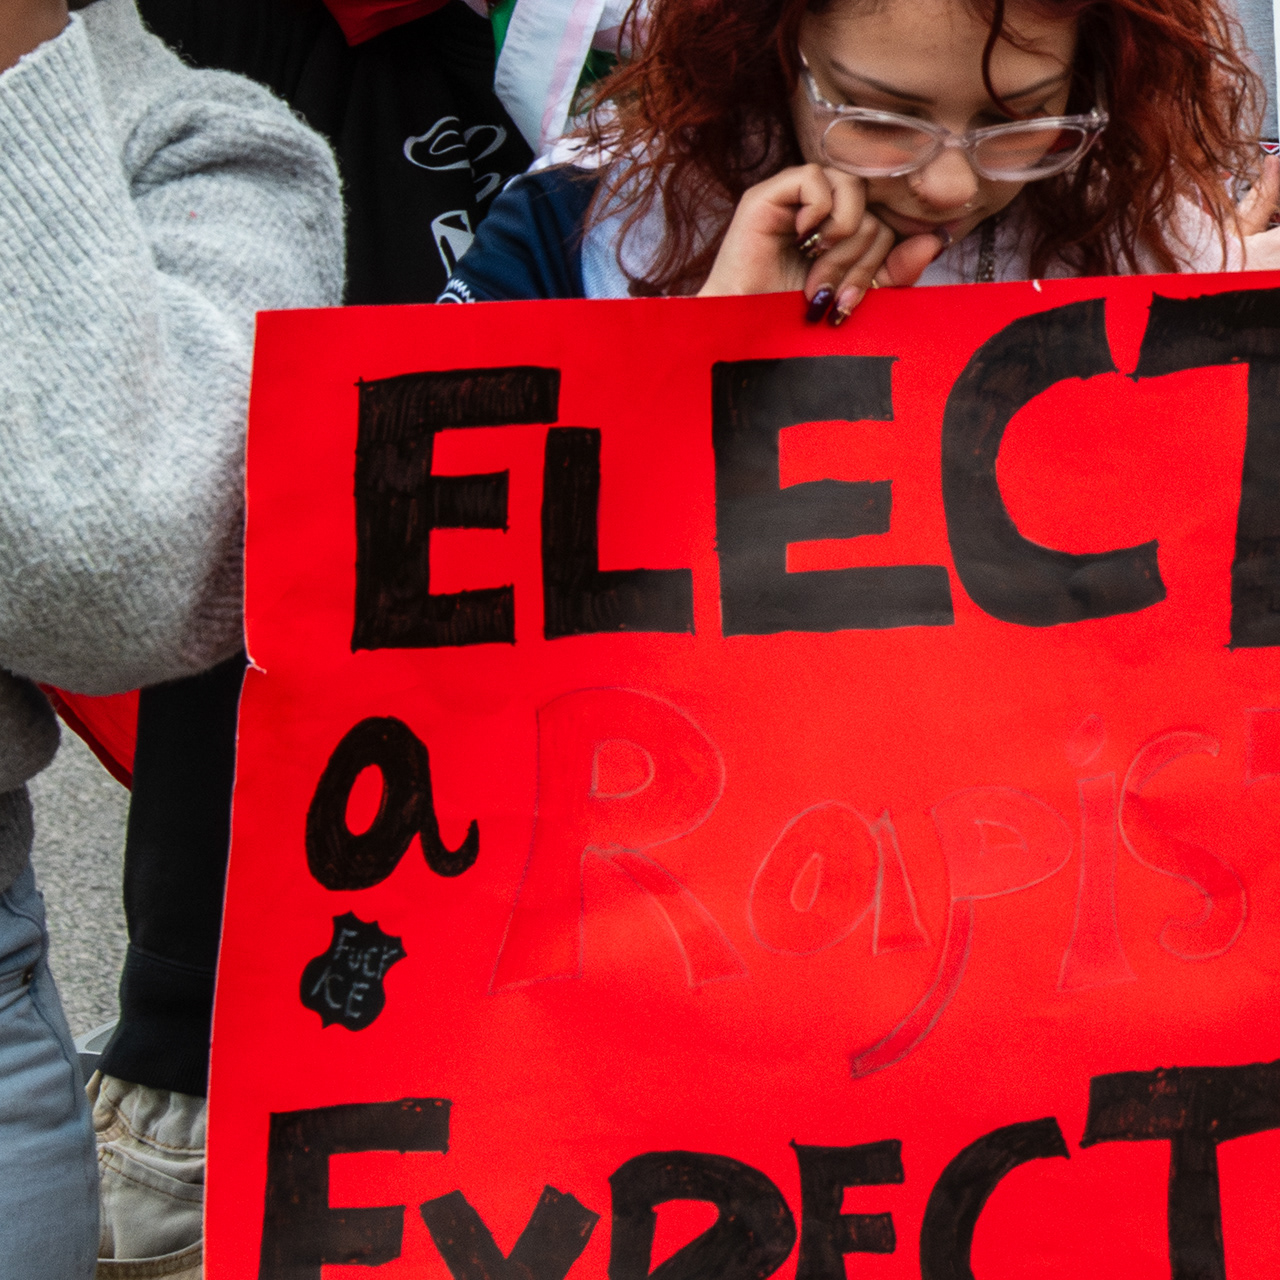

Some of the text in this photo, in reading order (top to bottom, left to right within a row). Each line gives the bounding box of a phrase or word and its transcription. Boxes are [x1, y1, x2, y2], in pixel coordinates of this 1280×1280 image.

[305, 715, 480, 892] a
[333, 927, 399, 981] FUCK
[310, 965, 370, 1019] ICE
